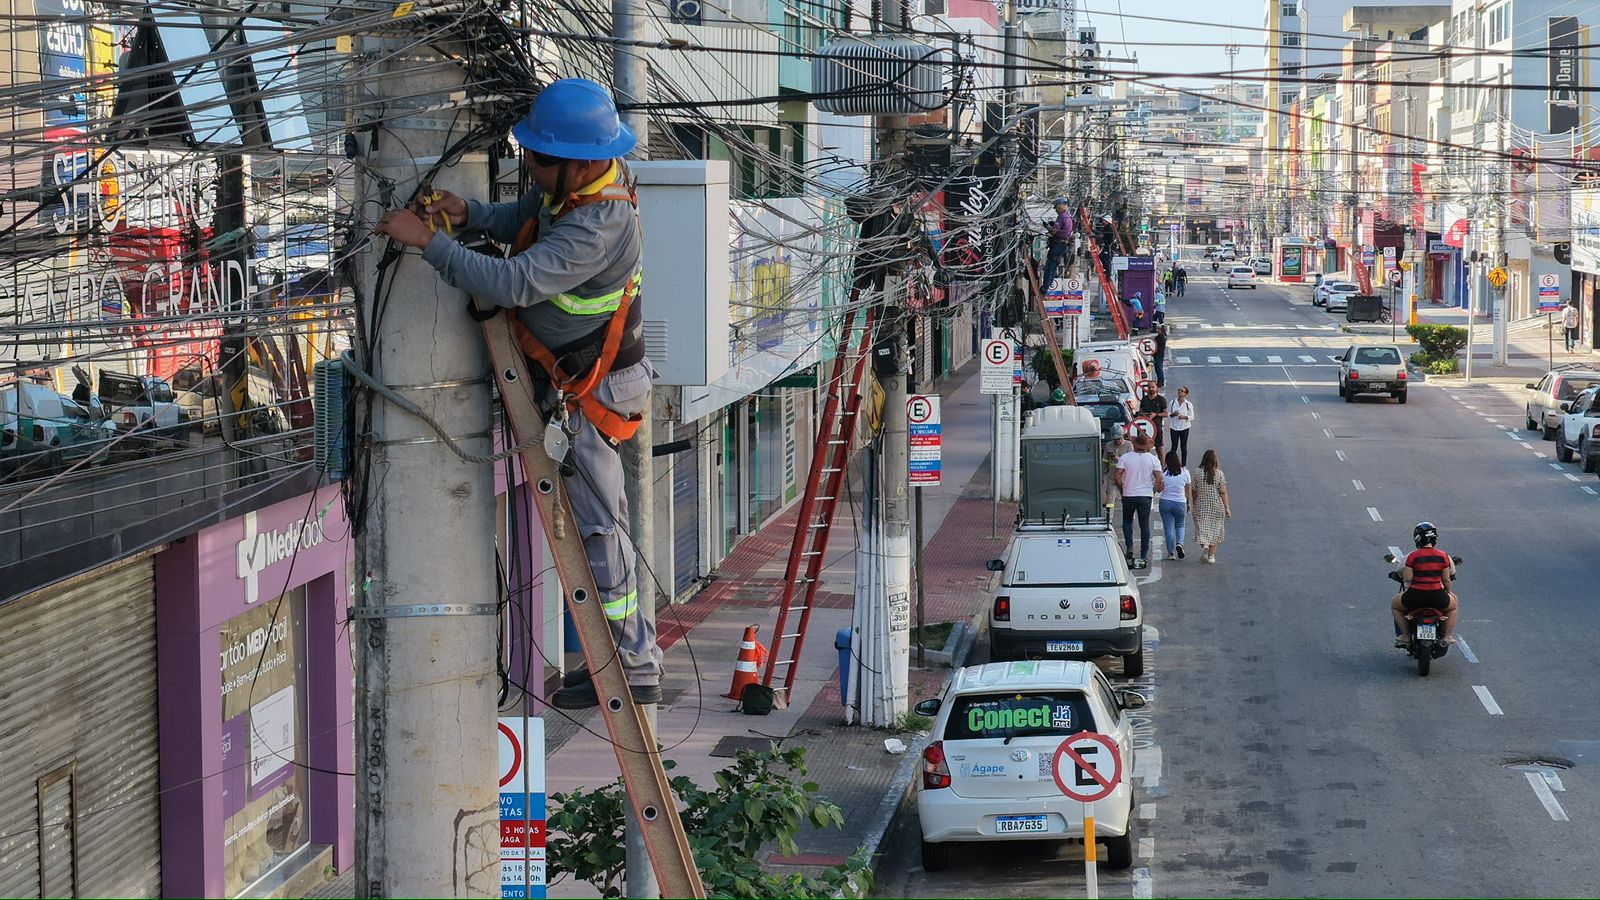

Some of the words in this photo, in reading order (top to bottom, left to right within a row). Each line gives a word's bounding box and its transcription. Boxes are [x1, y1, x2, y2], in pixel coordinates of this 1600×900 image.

[53, 150, 217, 234] SHOPPING
[142, 258, 258, 335] GRANDE
[993, 346, 1001, 359] E
[914, 403, 923, 417] E
[969, 705, 1051, 732] Conect
[1053, 705, 1071, 721] Já
[972, 762, 1005, 774] Ágape
[1074, 747, 1099, 786] E
[1001, 820, 1043, 831] RBA7G35
